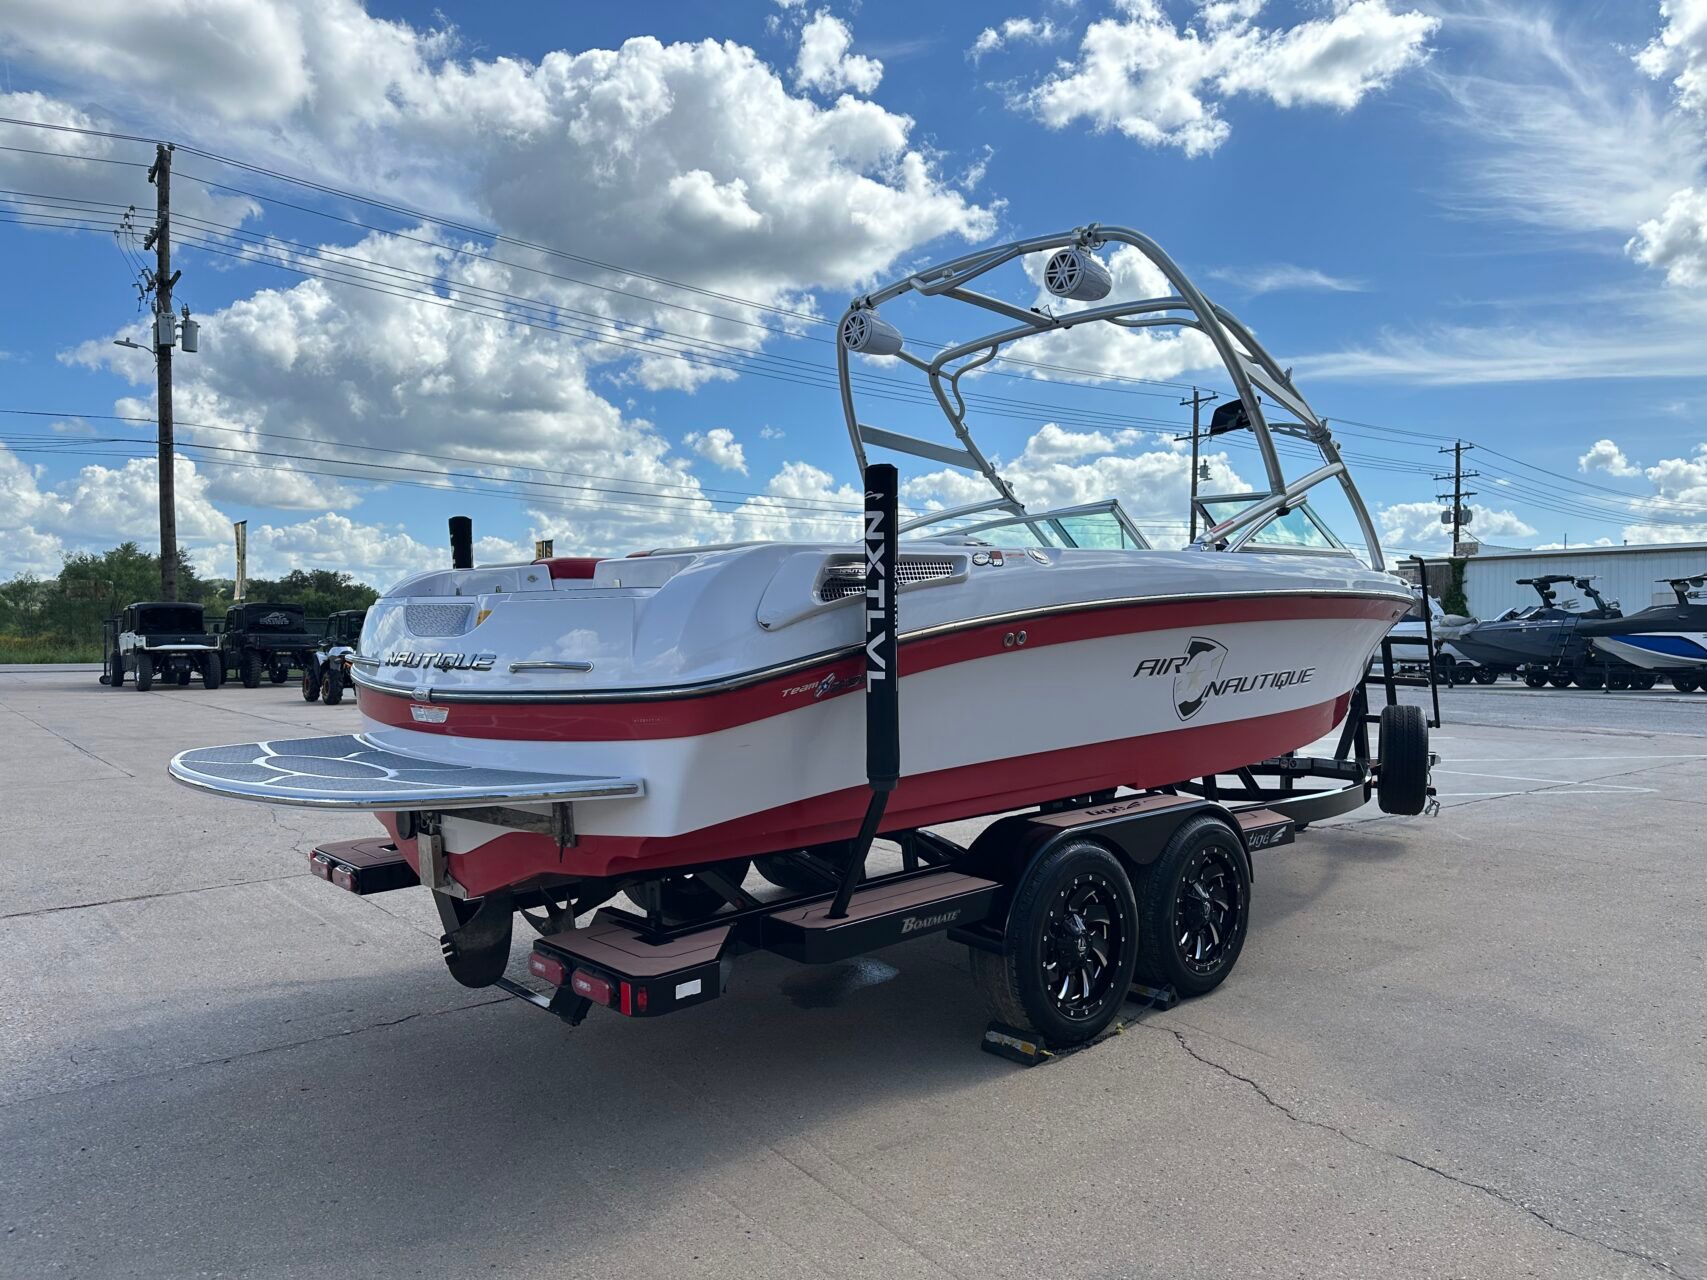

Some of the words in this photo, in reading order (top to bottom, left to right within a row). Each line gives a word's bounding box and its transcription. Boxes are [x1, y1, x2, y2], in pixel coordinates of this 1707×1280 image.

[864, 510, 886, 692] NXTLVL
[385, 651, 497, 672] NAUTIQUE
[1133, 657, 1188, 677] AIR
[1205, 668, 1315, 697] NAUTIQUE
